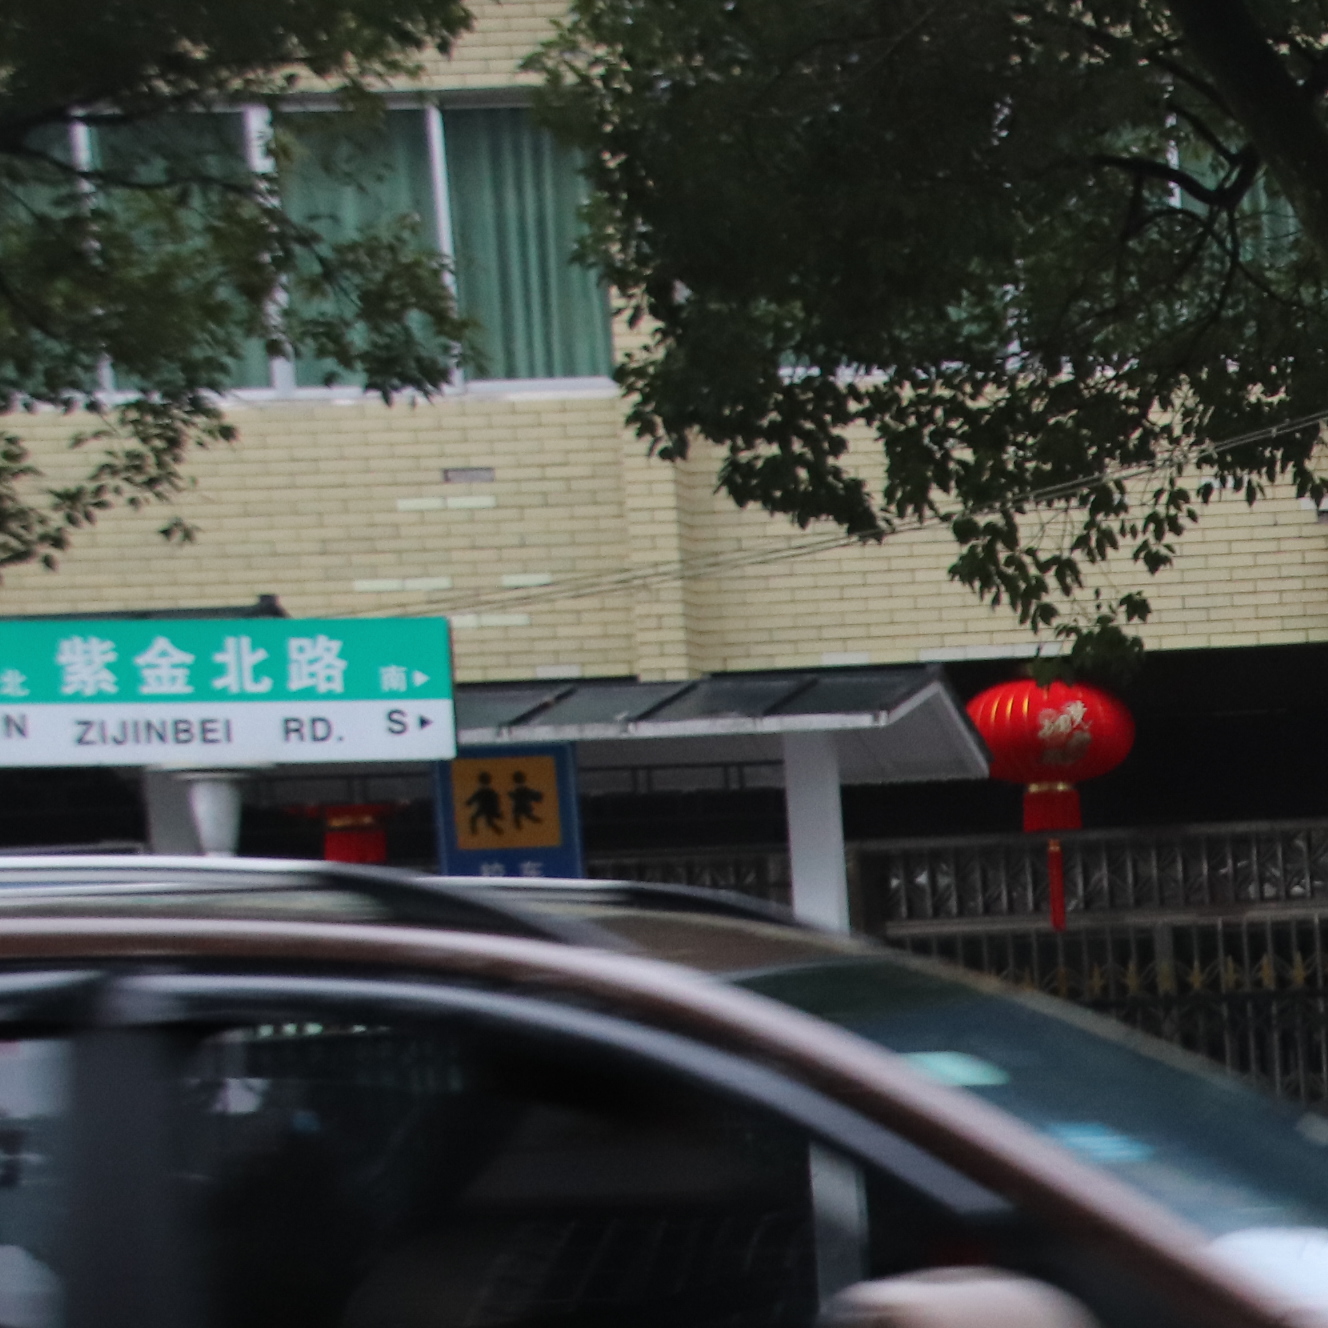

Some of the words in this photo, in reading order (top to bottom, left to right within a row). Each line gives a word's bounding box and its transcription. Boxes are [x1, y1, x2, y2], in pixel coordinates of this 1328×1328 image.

[56, 634, 348, 696] 紫金北路
[379, 665, 407, 692] 南
[3, 713, 28, 739] N
[75, 718, 233, 746] ZIJINBEI
[283, 716, 345, 743] RD.
[386, 708, 408, 735] S
